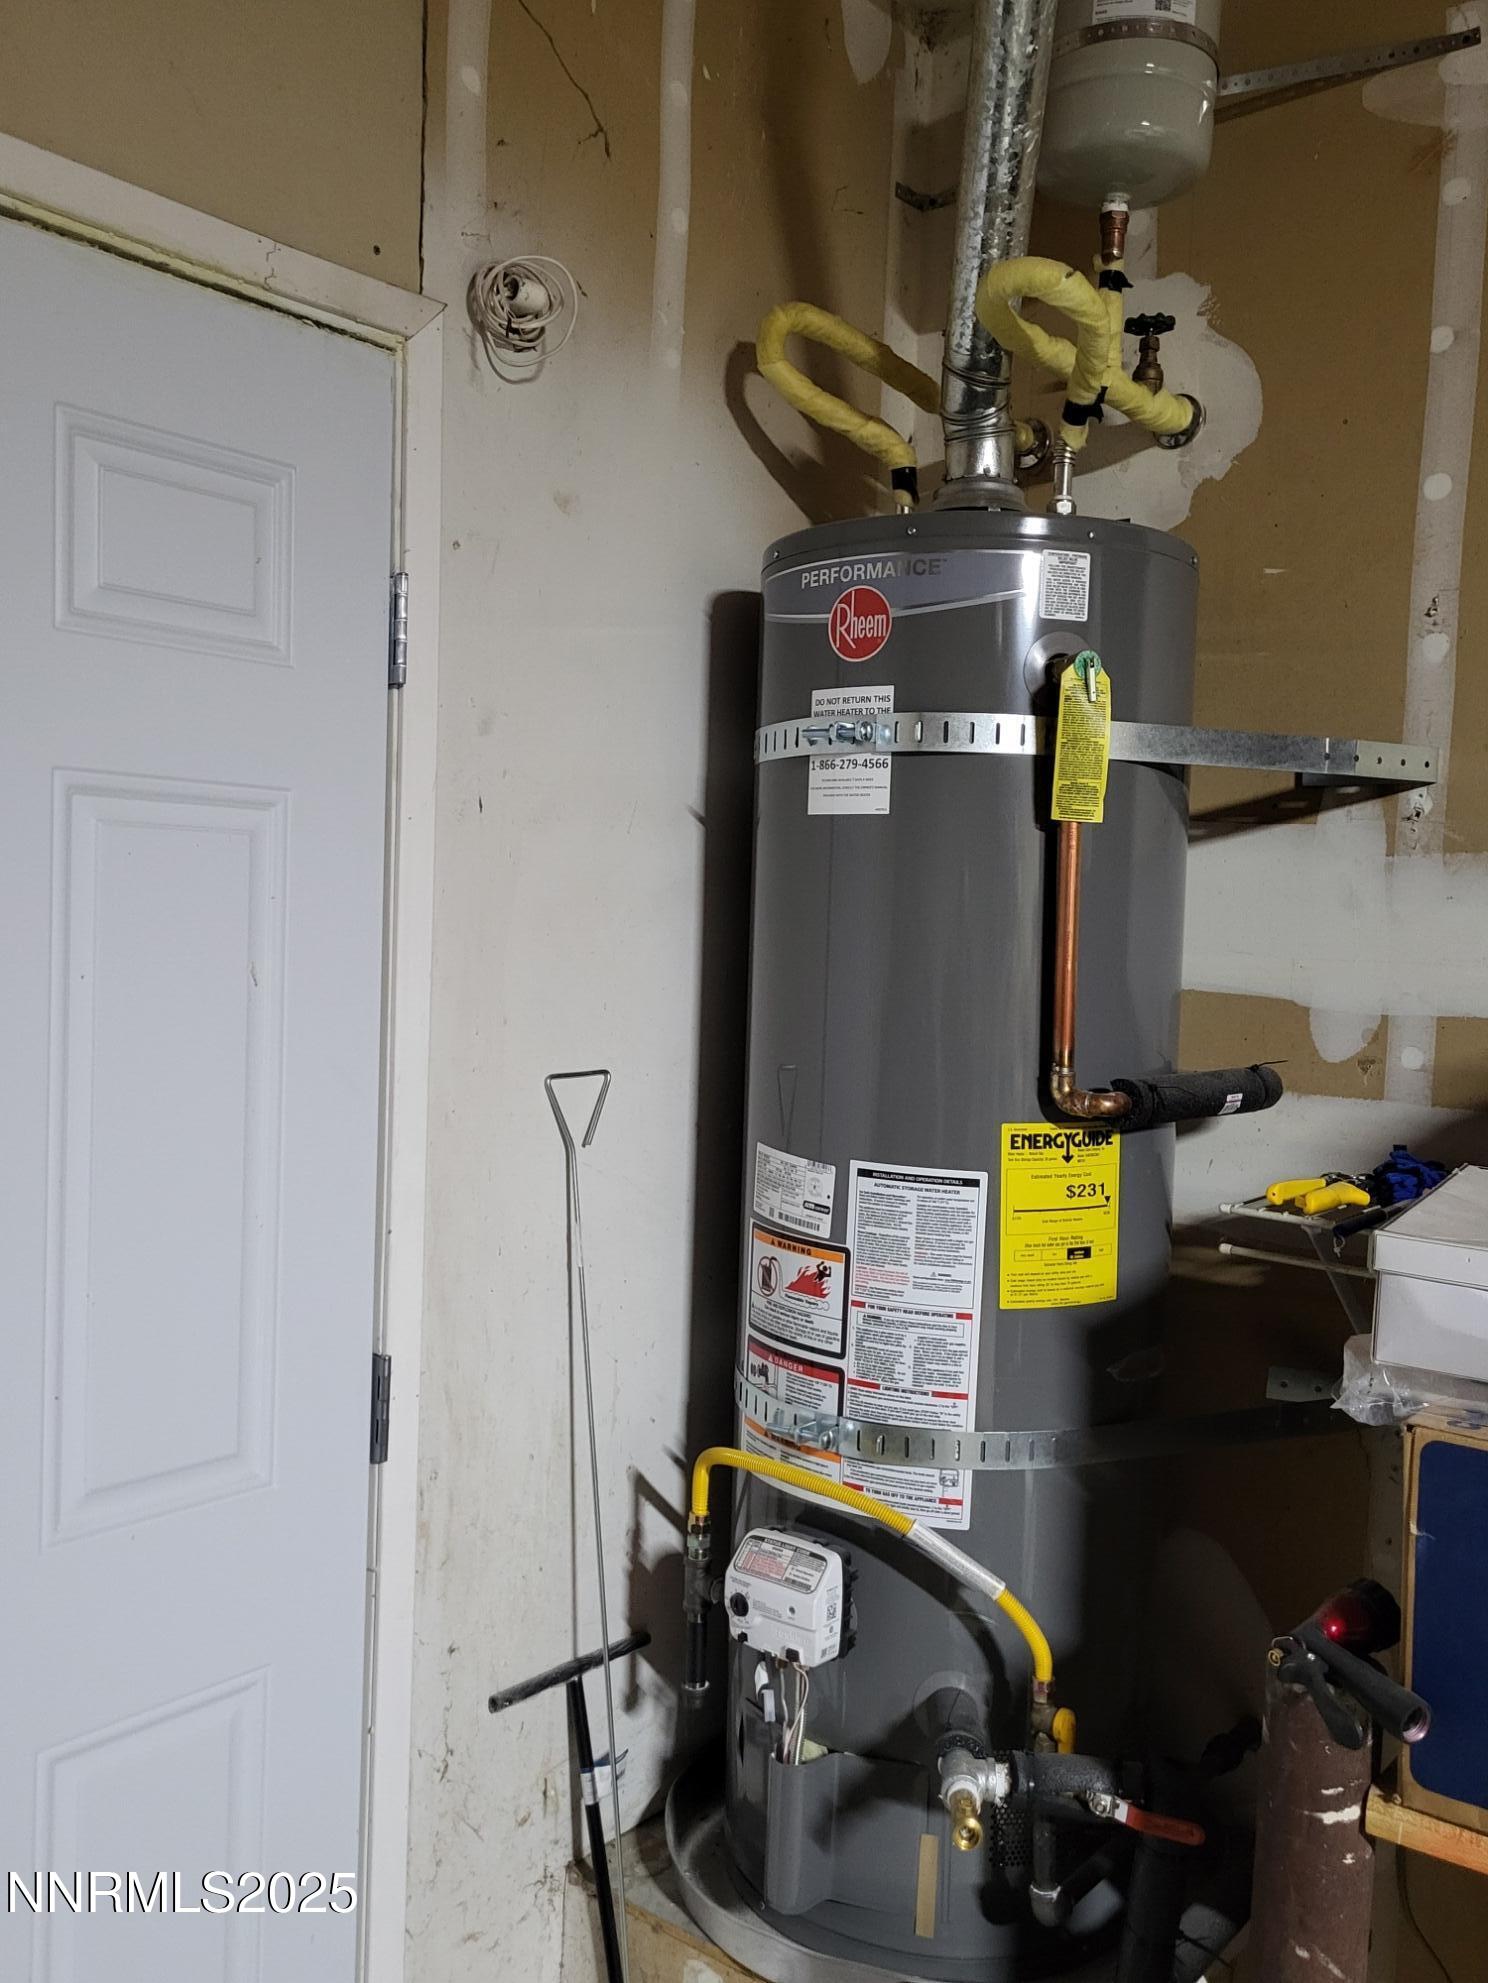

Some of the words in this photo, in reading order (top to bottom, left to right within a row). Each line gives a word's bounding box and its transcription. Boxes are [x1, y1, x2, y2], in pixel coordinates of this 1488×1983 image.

[801, 558, 942, 589] PERFORMANCE
[836, 591, 886, 648] Rheem
[826, 697, 841, 705] NOT
[842, 696, 872, 704] RETURN
[873, 695, 891, 703] THIS
[813, 709, 836, 718] WATER
[836, 708, 863, 717] HEATER
[863, 707, 875, 715] TO
[876, 707, 891, 715] THE
[811, 758, 889, 771] 1-866-279-4566
[1010, 1130, 1113, 1150] ENERGYGUIDE
[1066, 1182, 1105, 1200] $231
[777, 1240, 812, 1256] WARNING
[774, 1356, 804, 1372] DANGER
